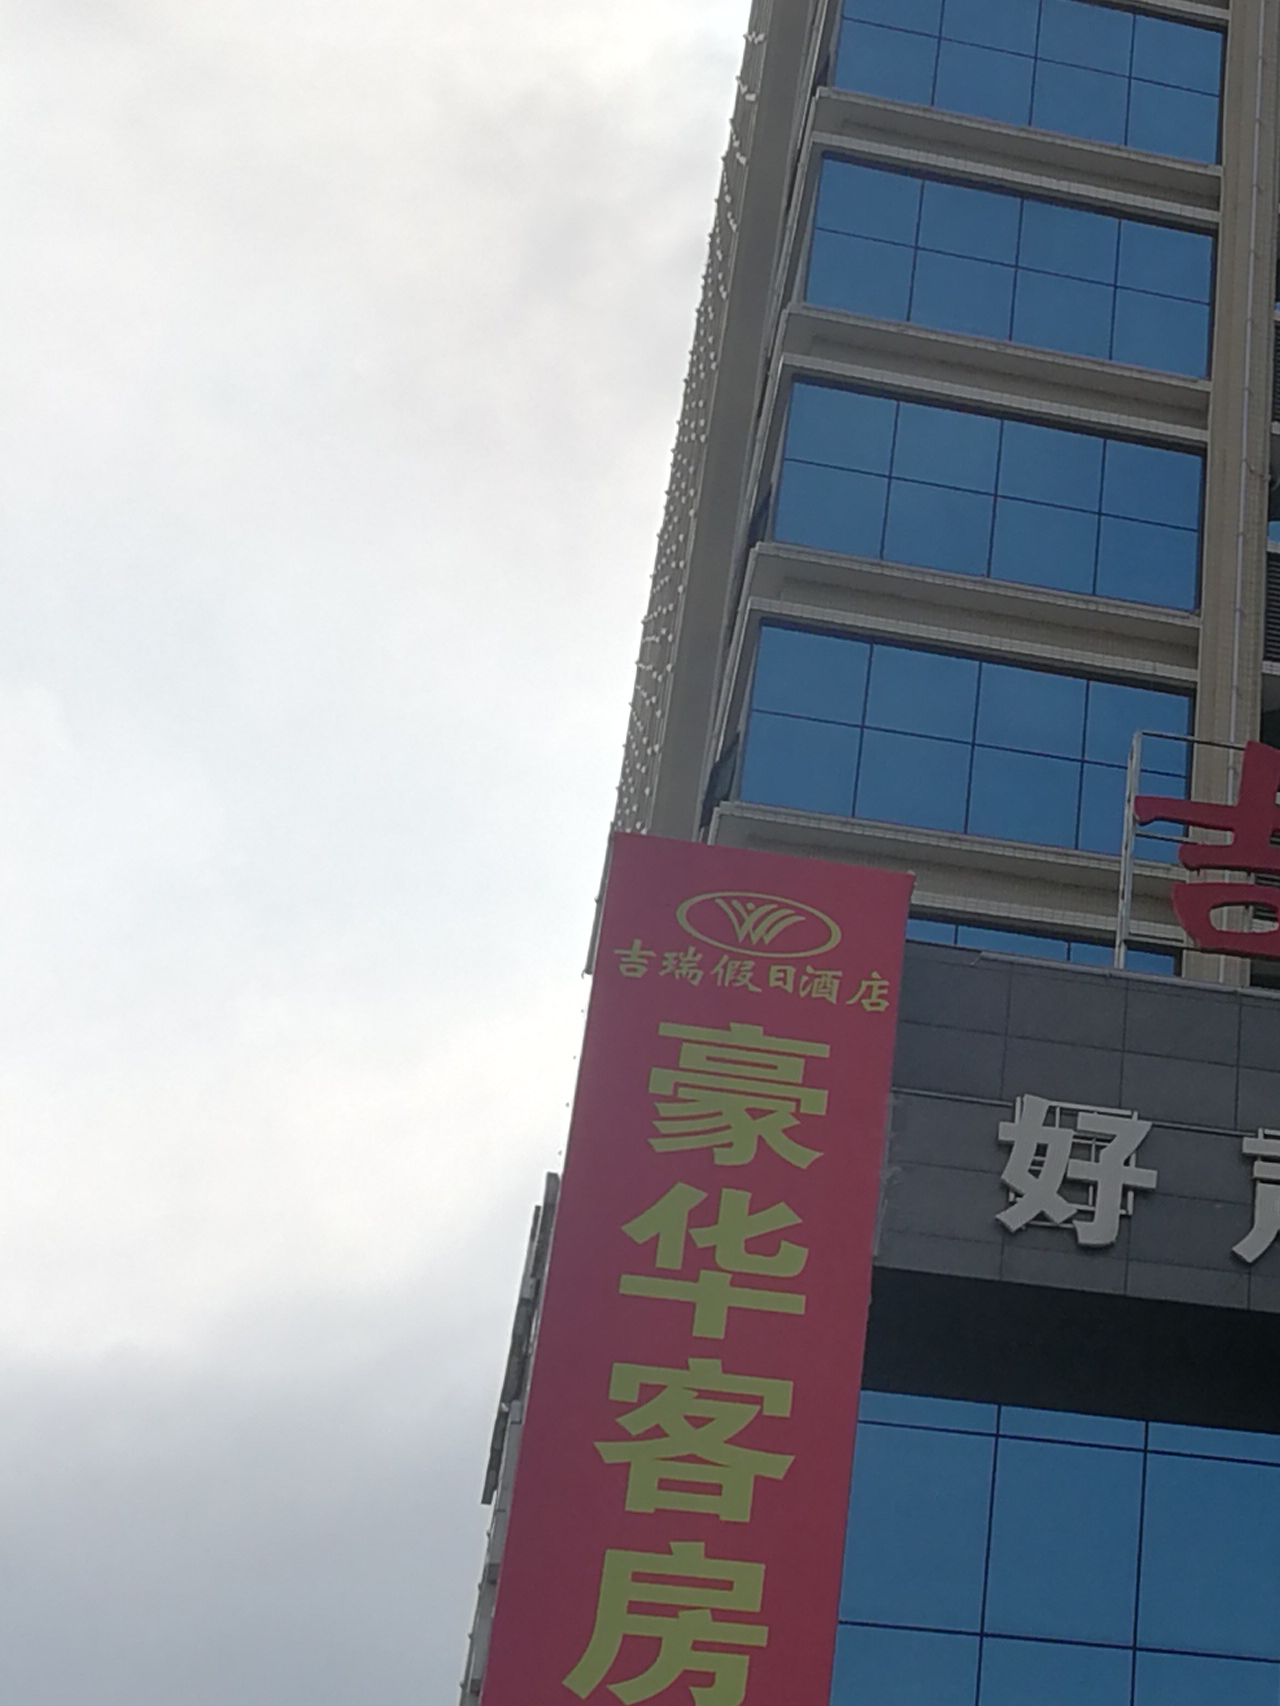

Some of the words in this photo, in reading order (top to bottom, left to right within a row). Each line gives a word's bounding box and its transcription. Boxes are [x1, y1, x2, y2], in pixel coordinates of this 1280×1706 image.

[613, 938, 891, 1012] 吉瑞假日酒店
